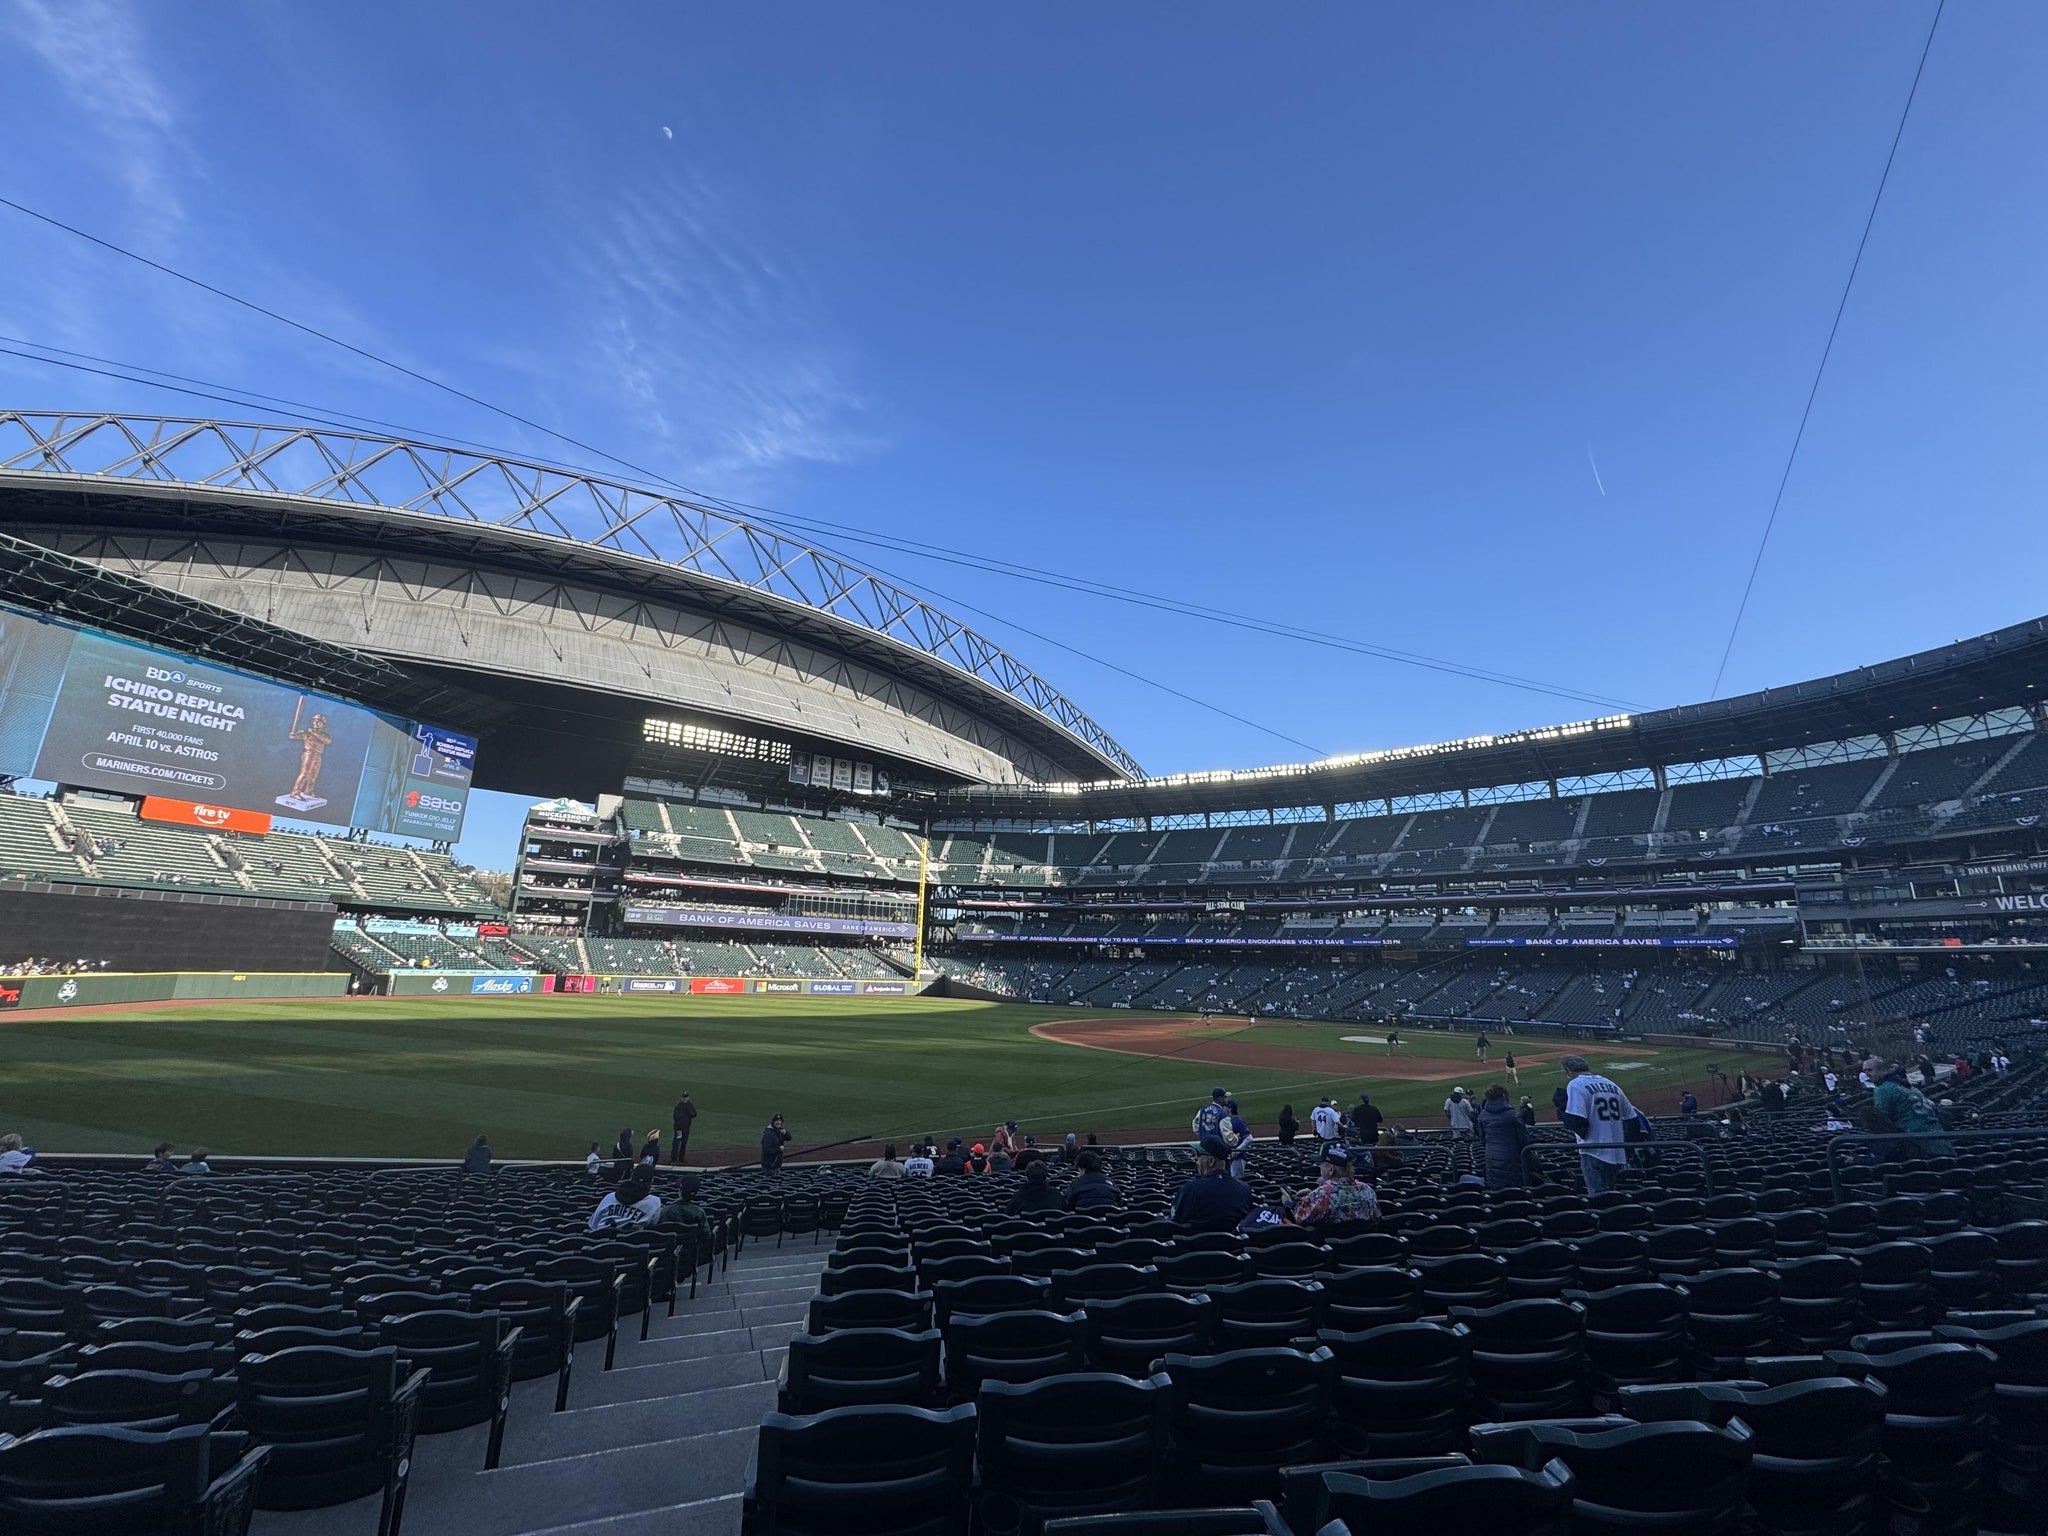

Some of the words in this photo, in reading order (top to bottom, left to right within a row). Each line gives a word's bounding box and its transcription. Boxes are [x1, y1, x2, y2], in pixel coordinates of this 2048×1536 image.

[187, 679, 222, 693] SPORTS
[104, 675, 174, 702] ICHIRO
[175, 692, 245, 719] REPLICA
[108, 694, 178, 719] STATUE
[180, 709, 236, 732] NIGHT
[132, 725, 156, 736] FIRST
[157, 730, 182, 742] 40,000
[184, 735, 204, 746] FANS
[107, 732, 143, 747] APRIL
[145, 739, 158, 750] 10
[160, 743, 173, 753] vs.
[174, 745, 219, 761] ASTROS
[96, 758, 214, 786] MARINERS.COM/TICKETS
[419, 795, 462, 811] sato
[194, 805, 216, 817] fire
[218, 809, 231, 819] tv
[538, 811, 591, 821] MUCKLESHOOT
[1968, 866, 1990, 875] DAVE
[1991, 863, 2029, 874] NIEHAUS
[1230, 901, 1245, 911] CLUB
[679, 914, 715, 923] BANK
[718, 916, 734, 924] OF
[738, 917, 791, 928] AMERICA
[794, 921, 831, 930] SAVES
[475, 978, 513, 992] Alaska
[767, 983, 798, 991] Microsoft
[1595, 1097, 1620, 1121] 29
[1317, 1115, 1327, 1123] 44
[608, 1204, 647, 1222] GRIFFEY
